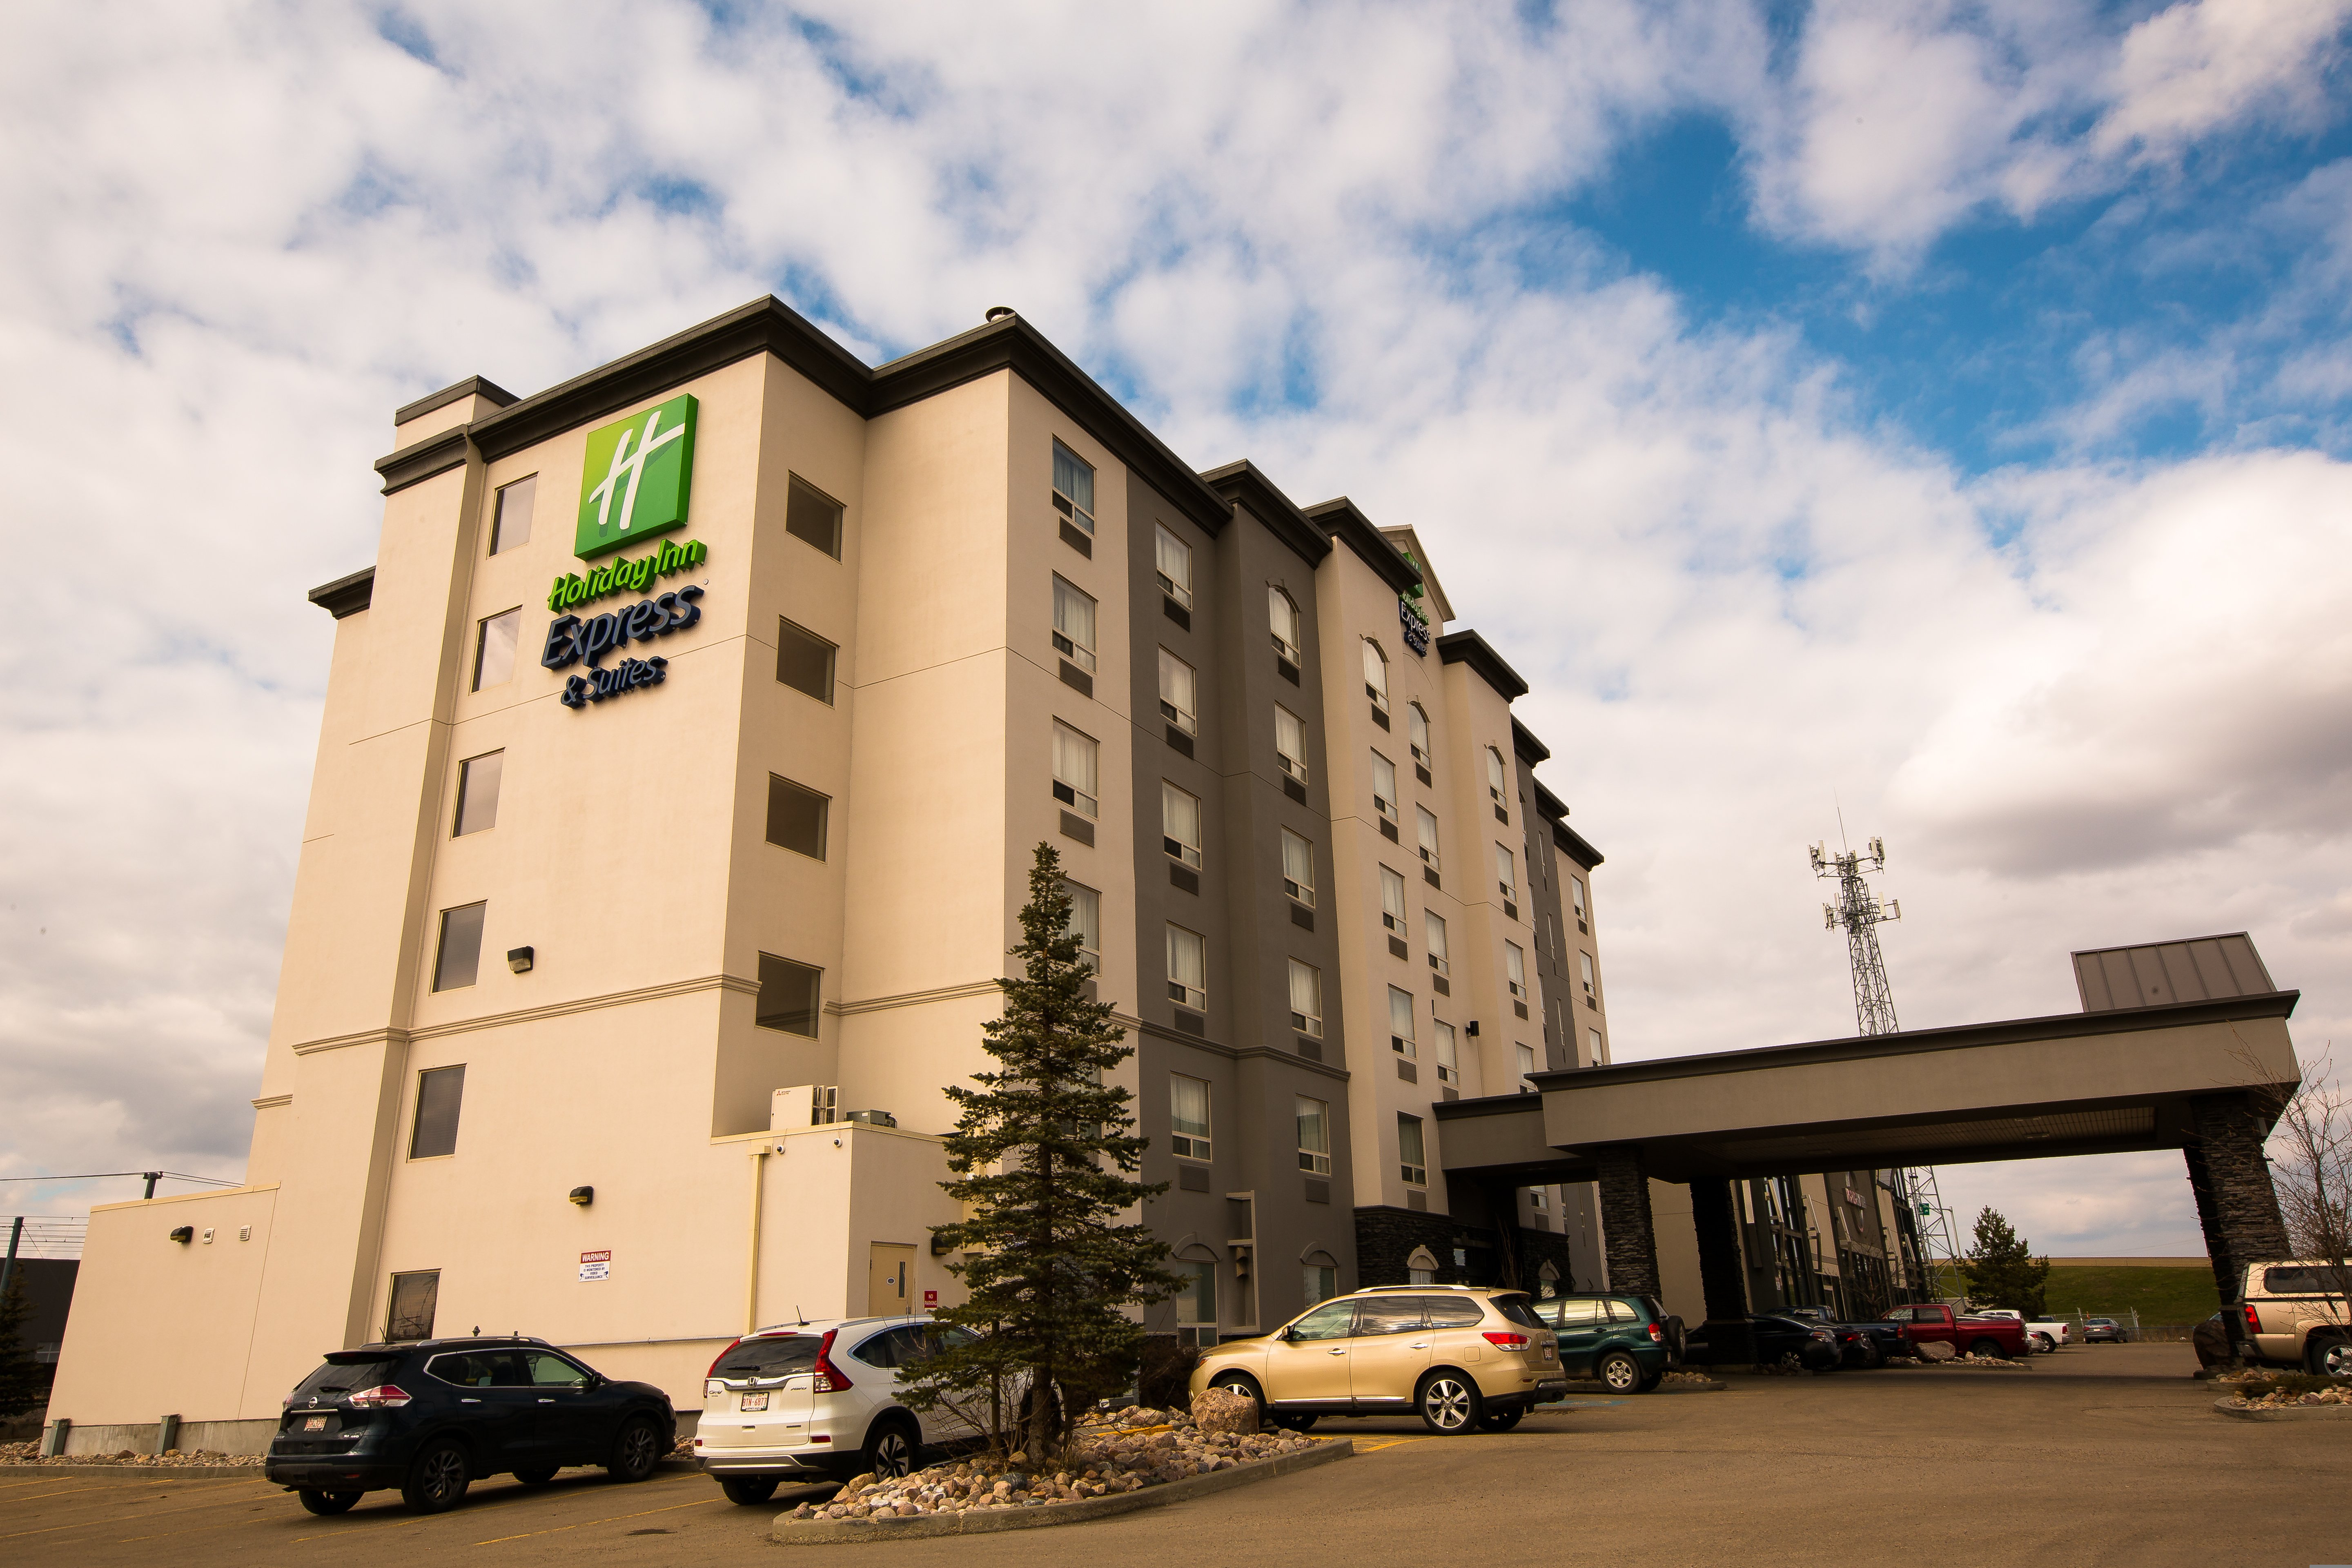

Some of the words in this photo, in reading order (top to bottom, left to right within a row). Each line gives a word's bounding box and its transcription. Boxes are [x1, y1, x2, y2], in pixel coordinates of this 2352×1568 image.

[548, 555, 655, 612] Holiday
[654, 539, 702, 574] Inn
[541, 585, 700, 668] Express
[1401, 601, 1430, 644] Express
[1421, 606, 1430, 624] Inn
[561, 675, 581, 706] &
[583, 656, 662, 700] Suites
[582, 1252, 609, 1262] WARNING
[742, 1398, 767, 1407] BTN-6877
